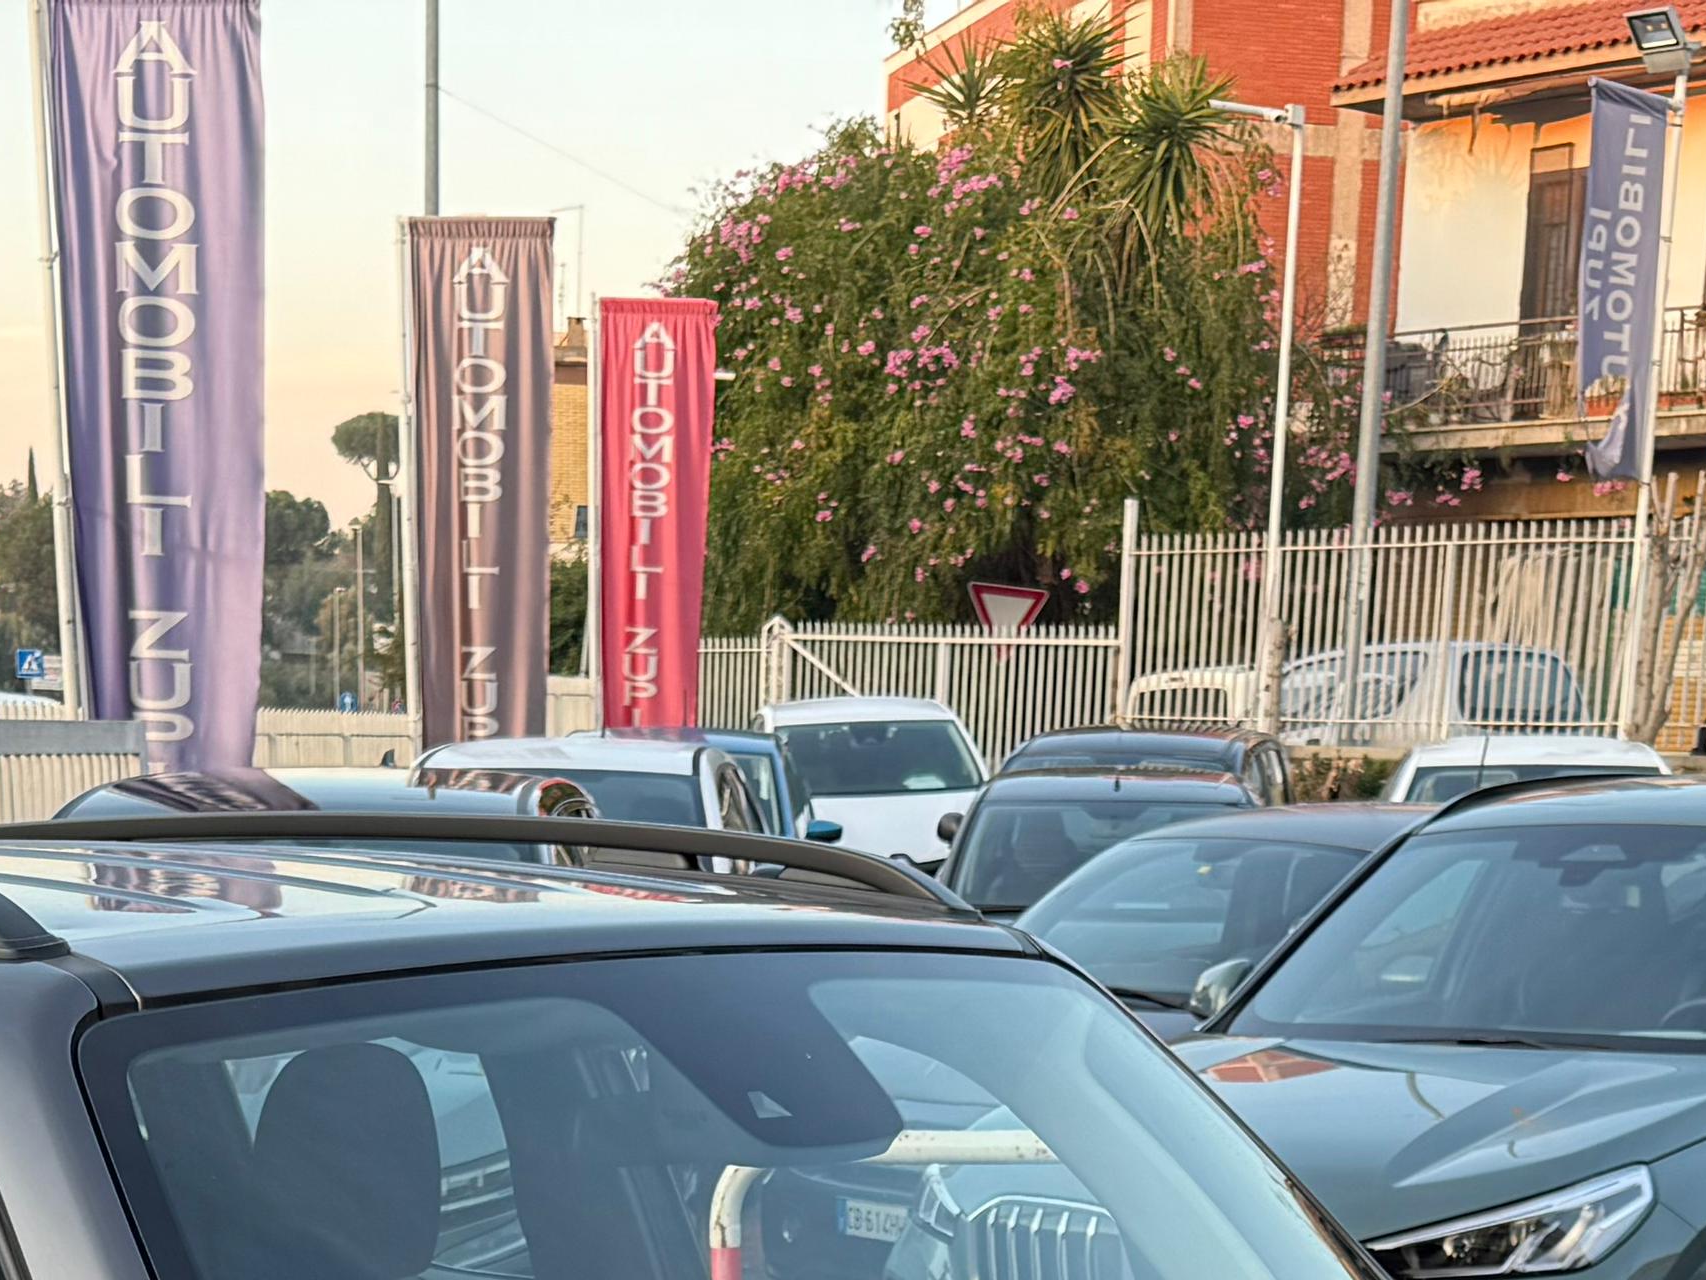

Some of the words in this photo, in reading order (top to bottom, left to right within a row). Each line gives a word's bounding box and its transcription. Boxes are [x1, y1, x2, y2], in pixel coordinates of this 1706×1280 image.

[113, 20, 199, 557] AUTOMOBILI
[452, 247, 509, 609] AUTOMOBILI
[629, 321, 676, 599] AUTOMOBILI
[128, 610, 194, 775] ZUP
[621, 626, 658, 728] ZUPI
